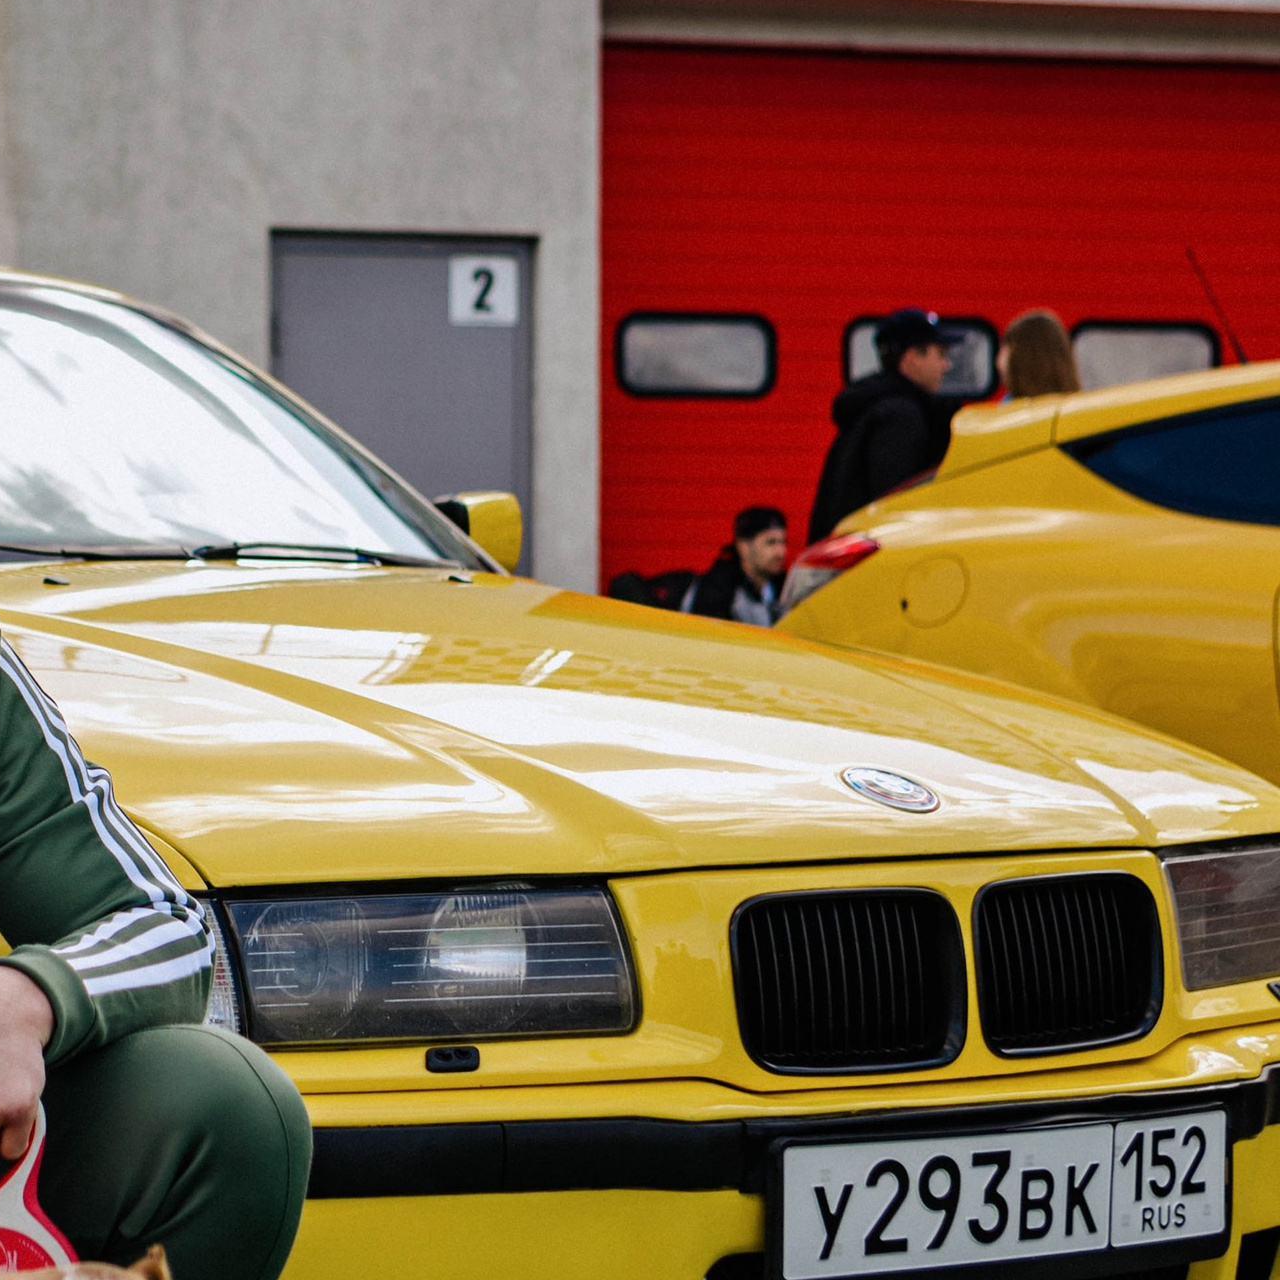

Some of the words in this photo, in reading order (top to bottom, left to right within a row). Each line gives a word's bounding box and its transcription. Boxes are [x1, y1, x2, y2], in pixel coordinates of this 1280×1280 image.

[473, 268, 494, 311] 2
[1120, 1125, 1207, 1202] 152
[1141, 1203, 1186, 1233] RUS
